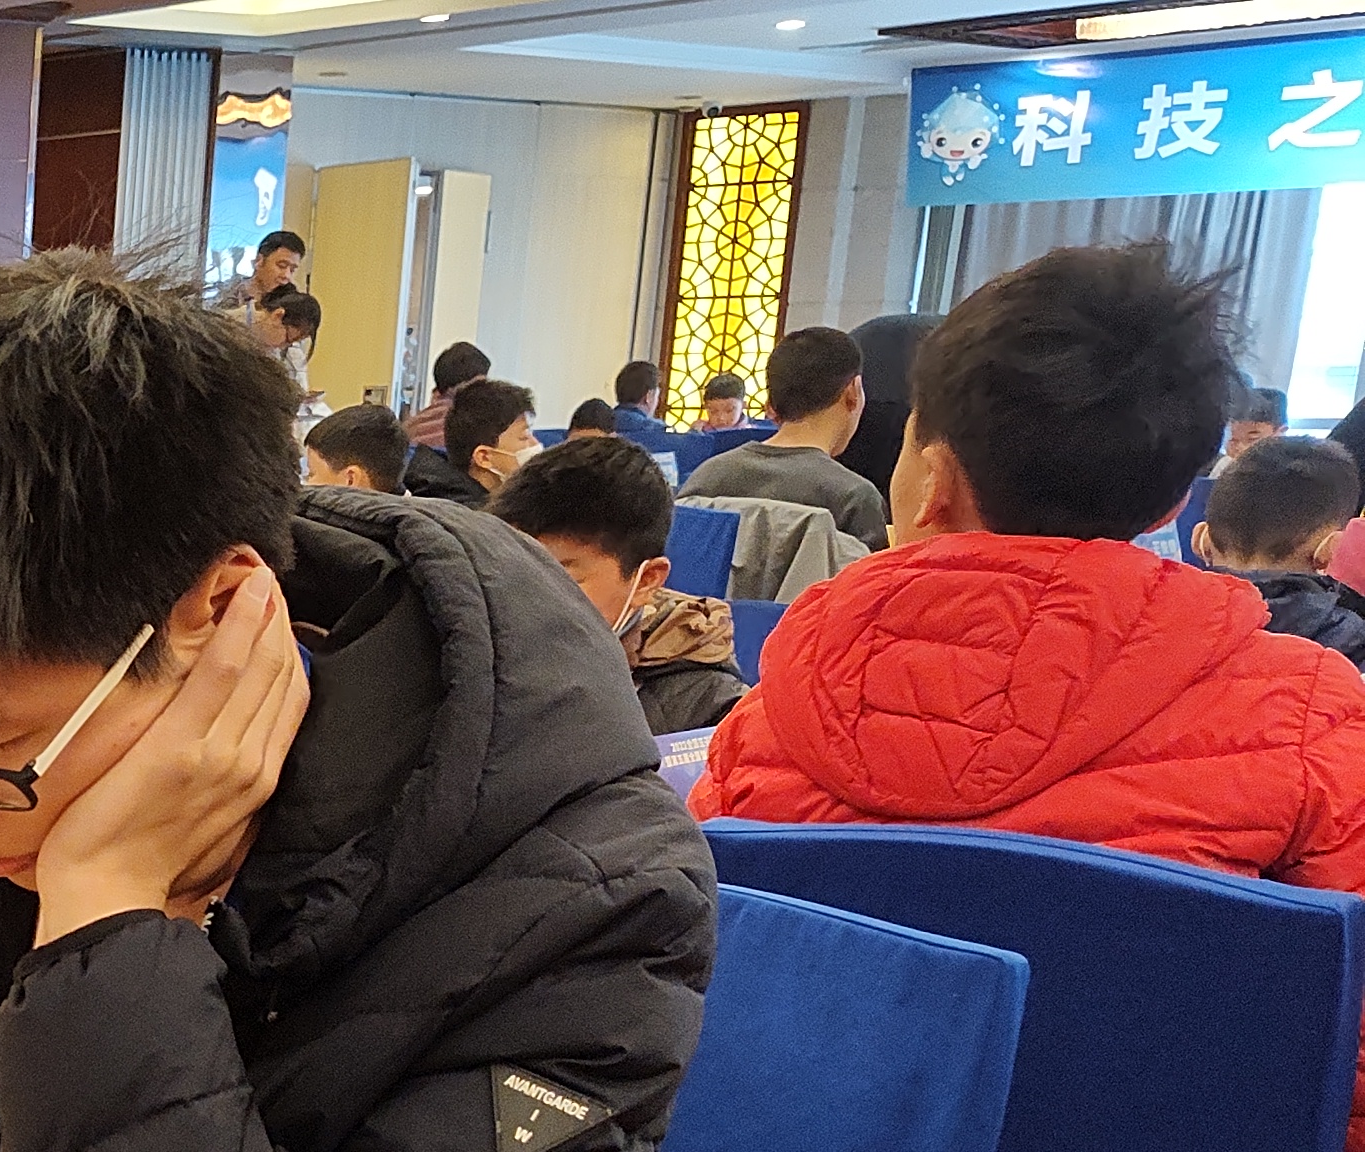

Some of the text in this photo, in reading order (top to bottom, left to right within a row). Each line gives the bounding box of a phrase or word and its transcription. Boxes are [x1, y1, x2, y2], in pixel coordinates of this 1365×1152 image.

[1012, 69, 1364, 168] 科技之
[503, 1074, 589, 1121] AVANTGARDE
